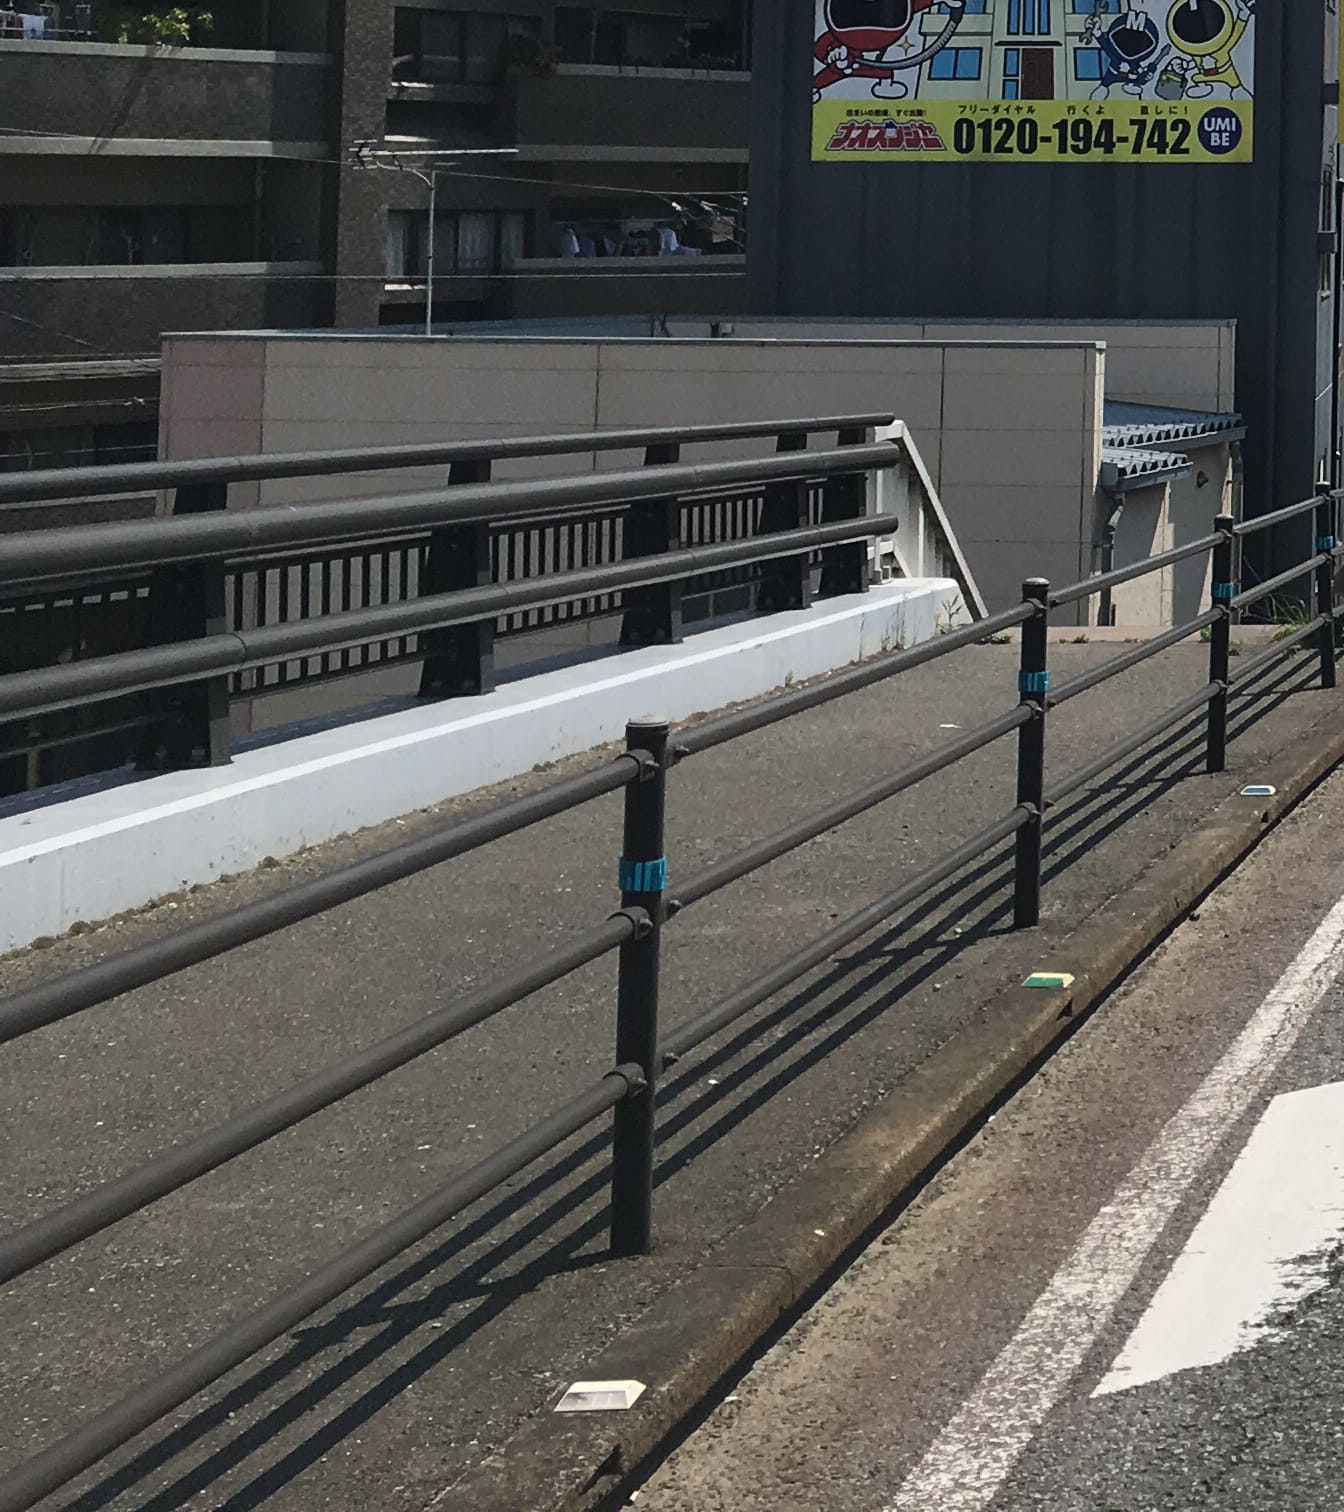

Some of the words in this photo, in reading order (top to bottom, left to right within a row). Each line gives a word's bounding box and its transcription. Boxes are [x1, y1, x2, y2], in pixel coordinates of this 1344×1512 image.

[1126, 10, 1146, 32] M
[958, 104, 1036, 115] フリーダイヤル
[1067, 104, 1105, 116] 行くよ
[1204, 116, 1236, 132] UMI
[954, 117, 1190, 155] 0120-194-742
[1210, 131, 1230, 146] BE
